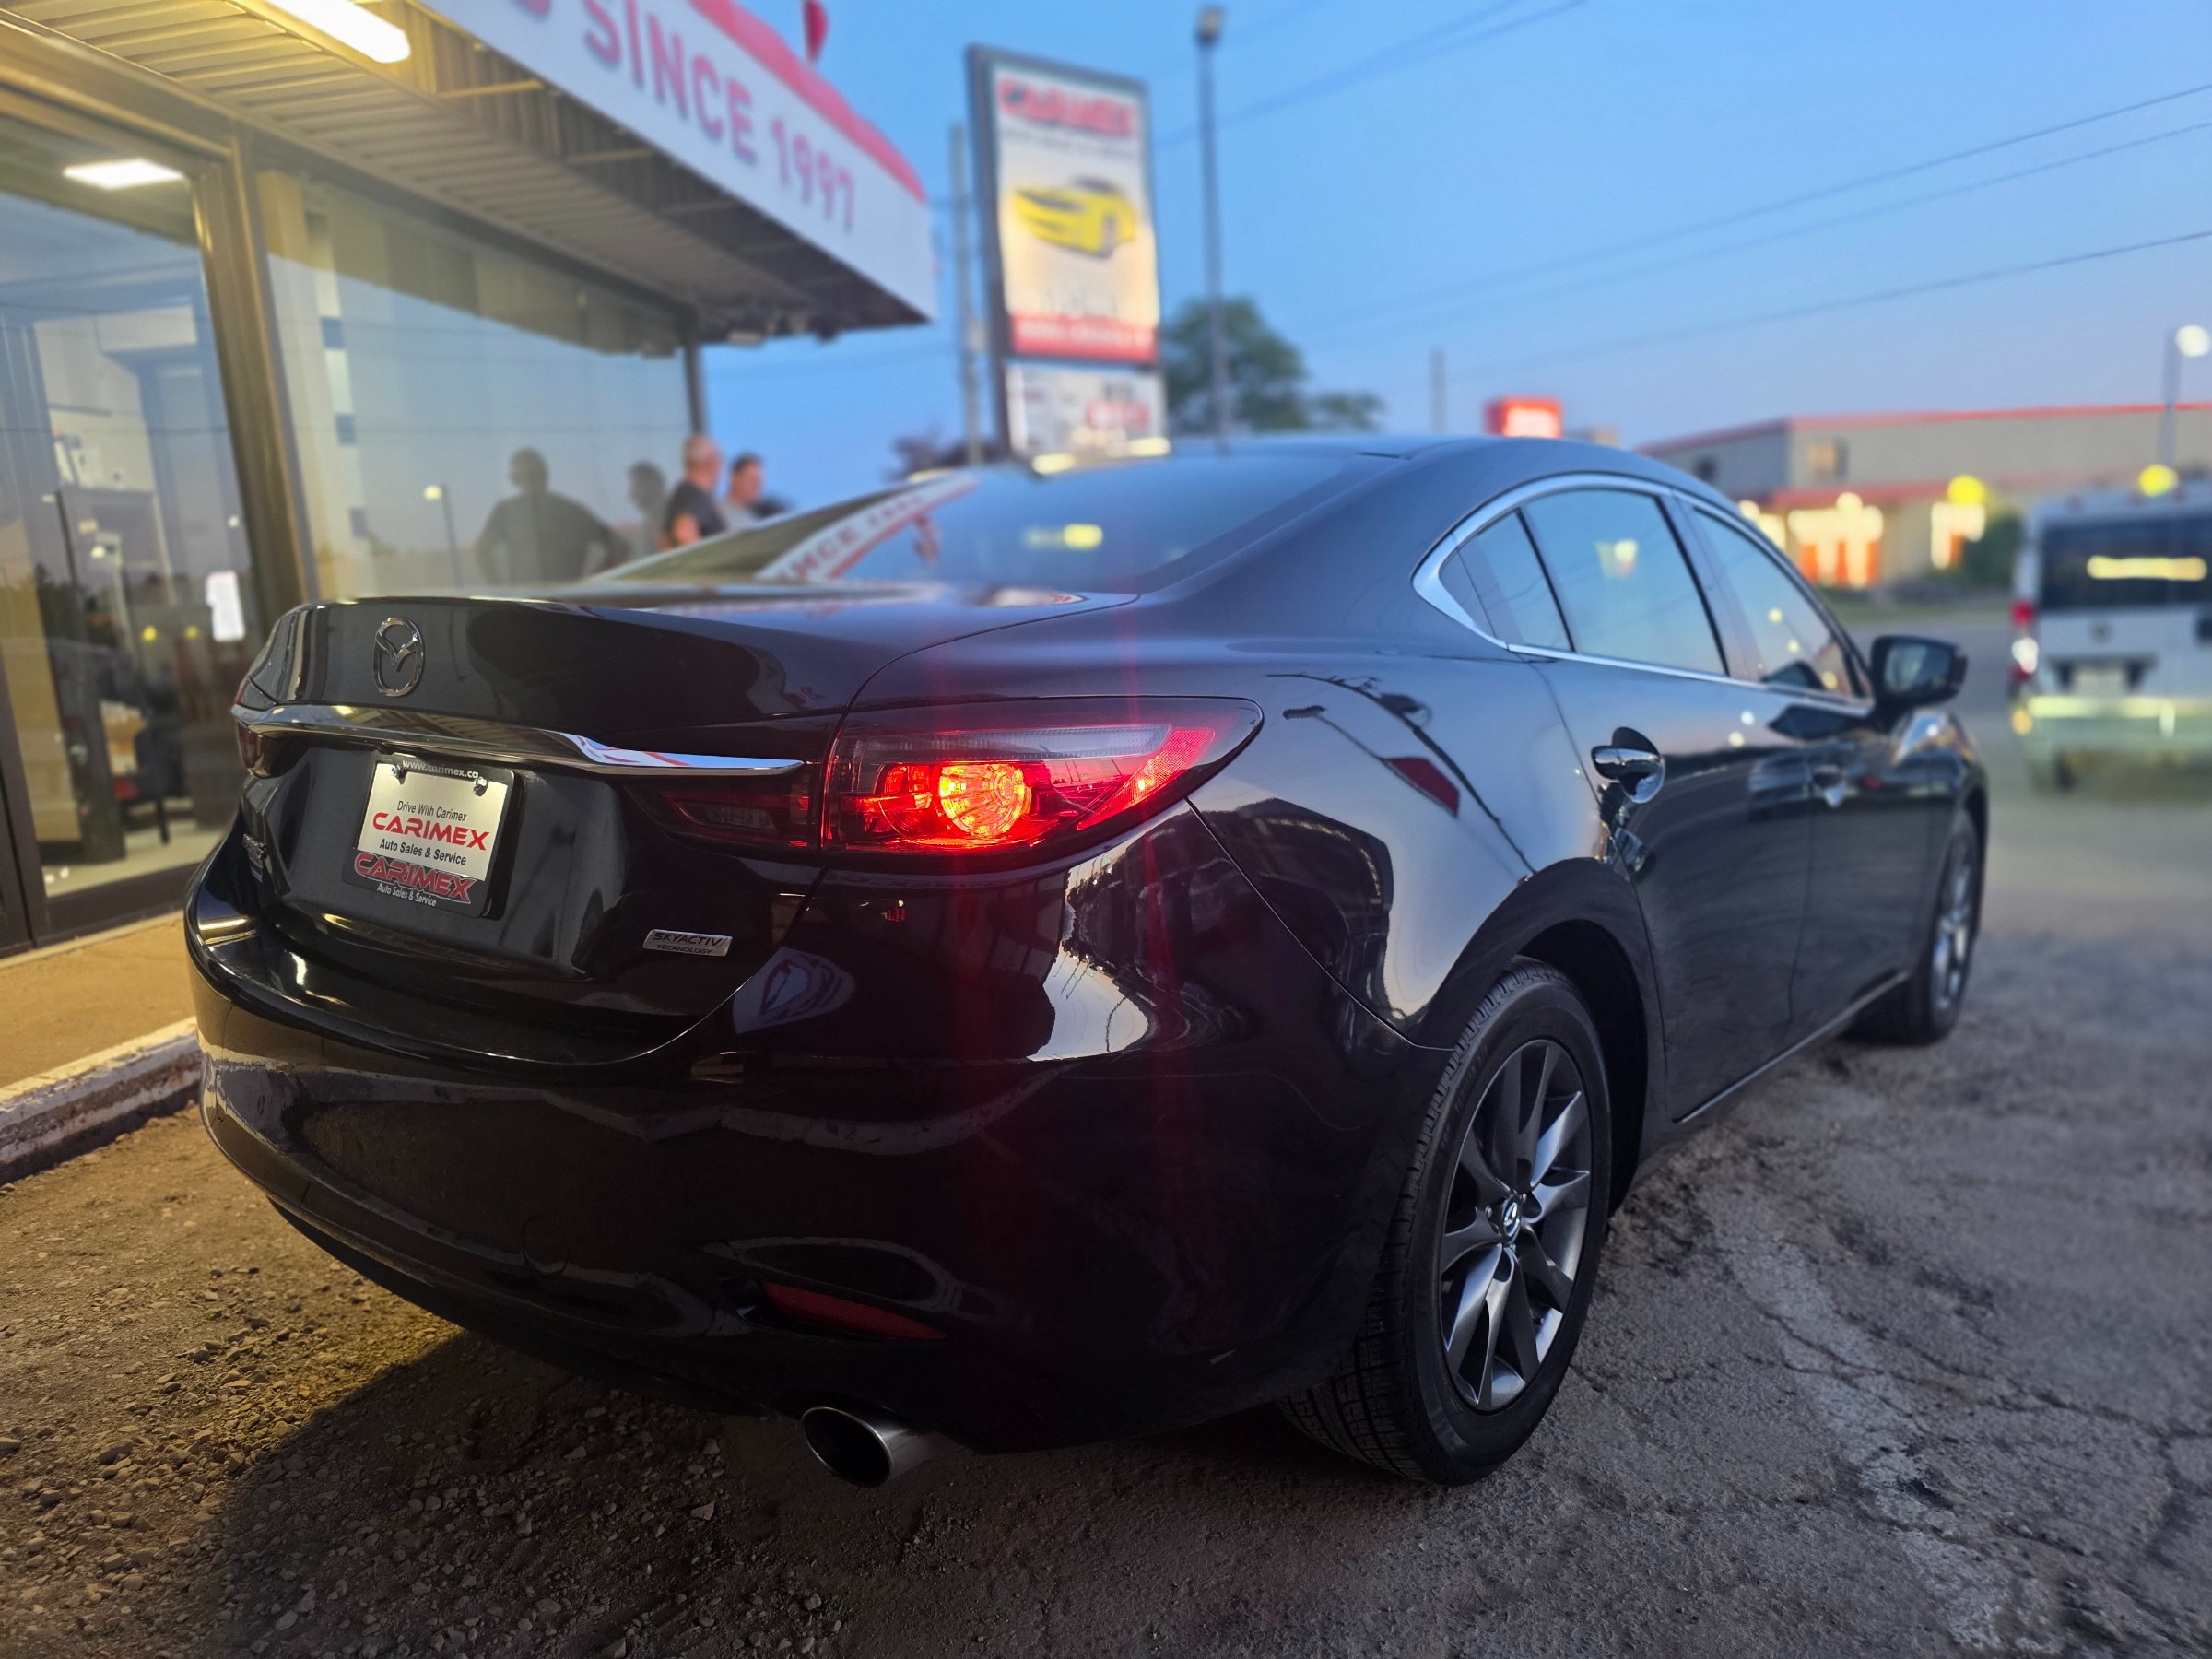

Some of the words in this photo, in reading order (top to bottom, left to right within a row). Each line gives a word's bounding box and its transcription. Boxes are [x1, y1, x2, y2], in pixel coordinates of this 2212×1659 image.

[584, 0, 758, 167] SINCE
[771, 116, 855, 234] 1997
[403, 759, 480, 779] www.carimex.ca
[397, 800, 417, 814] Drive
[418, 803, 434, 817] With
[436, 806, 467, 822] Carimex
[372, 812, 490, 852] CARIMEX
[380, 838, 398, 853] Auto
[400, 842, 423, 858] Sales
[424, 847, 431, 859] &
[433, 849, 467, 866] Service
[355, 853, 476, 903] CARIMEX
[377, 883, 392, 895] Auto
[392, 887, 408, 900] Sales
[408, 891, 415, 901] &
[415, 892, 437, 907] Service
[653, 932, 723, 947] SKYACTIV
[656, 944, 713, 955] TECHNOLOGY
